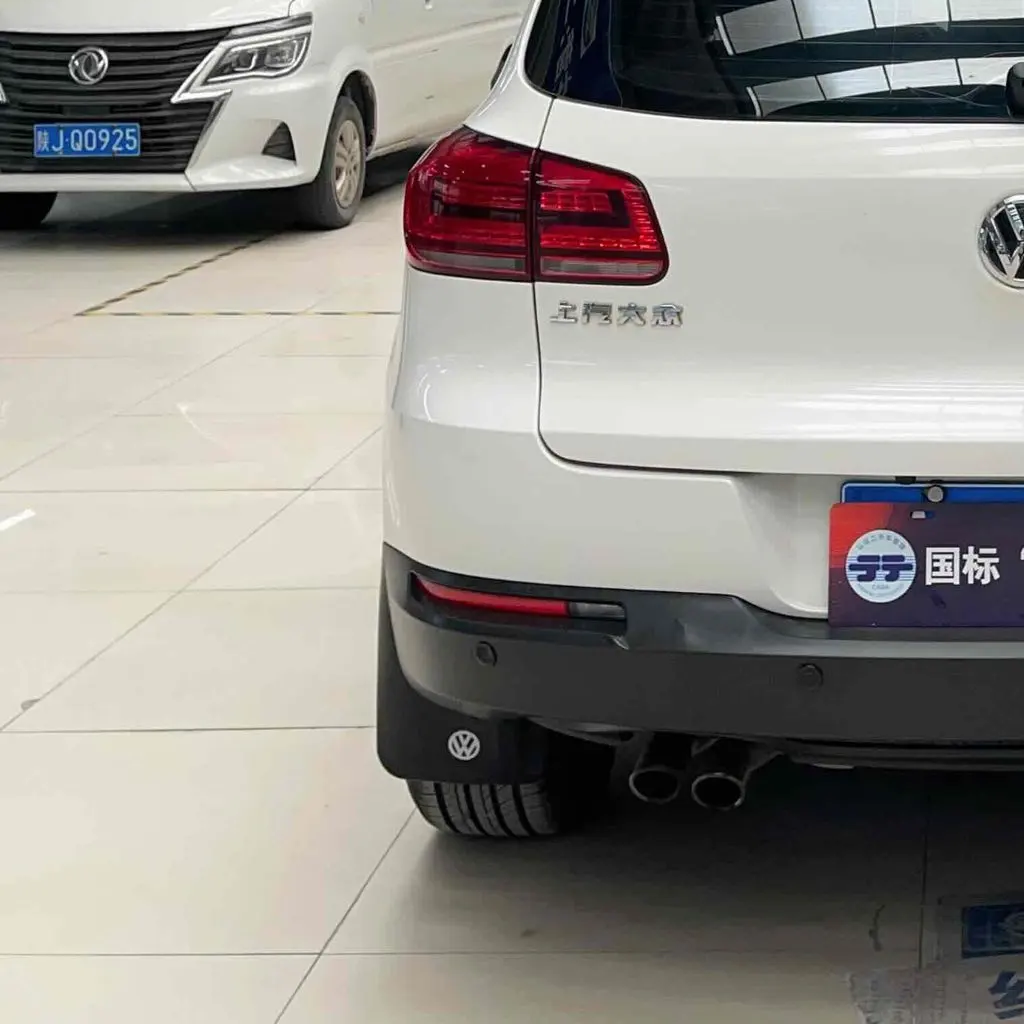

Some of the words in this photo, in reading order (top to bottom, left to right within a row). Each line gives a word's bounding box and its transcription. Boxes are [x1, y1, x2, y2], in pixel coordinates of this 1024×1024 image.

[550, 300, 684, 327] 上汽大众
[924, 546, 1000, 585] 国标
